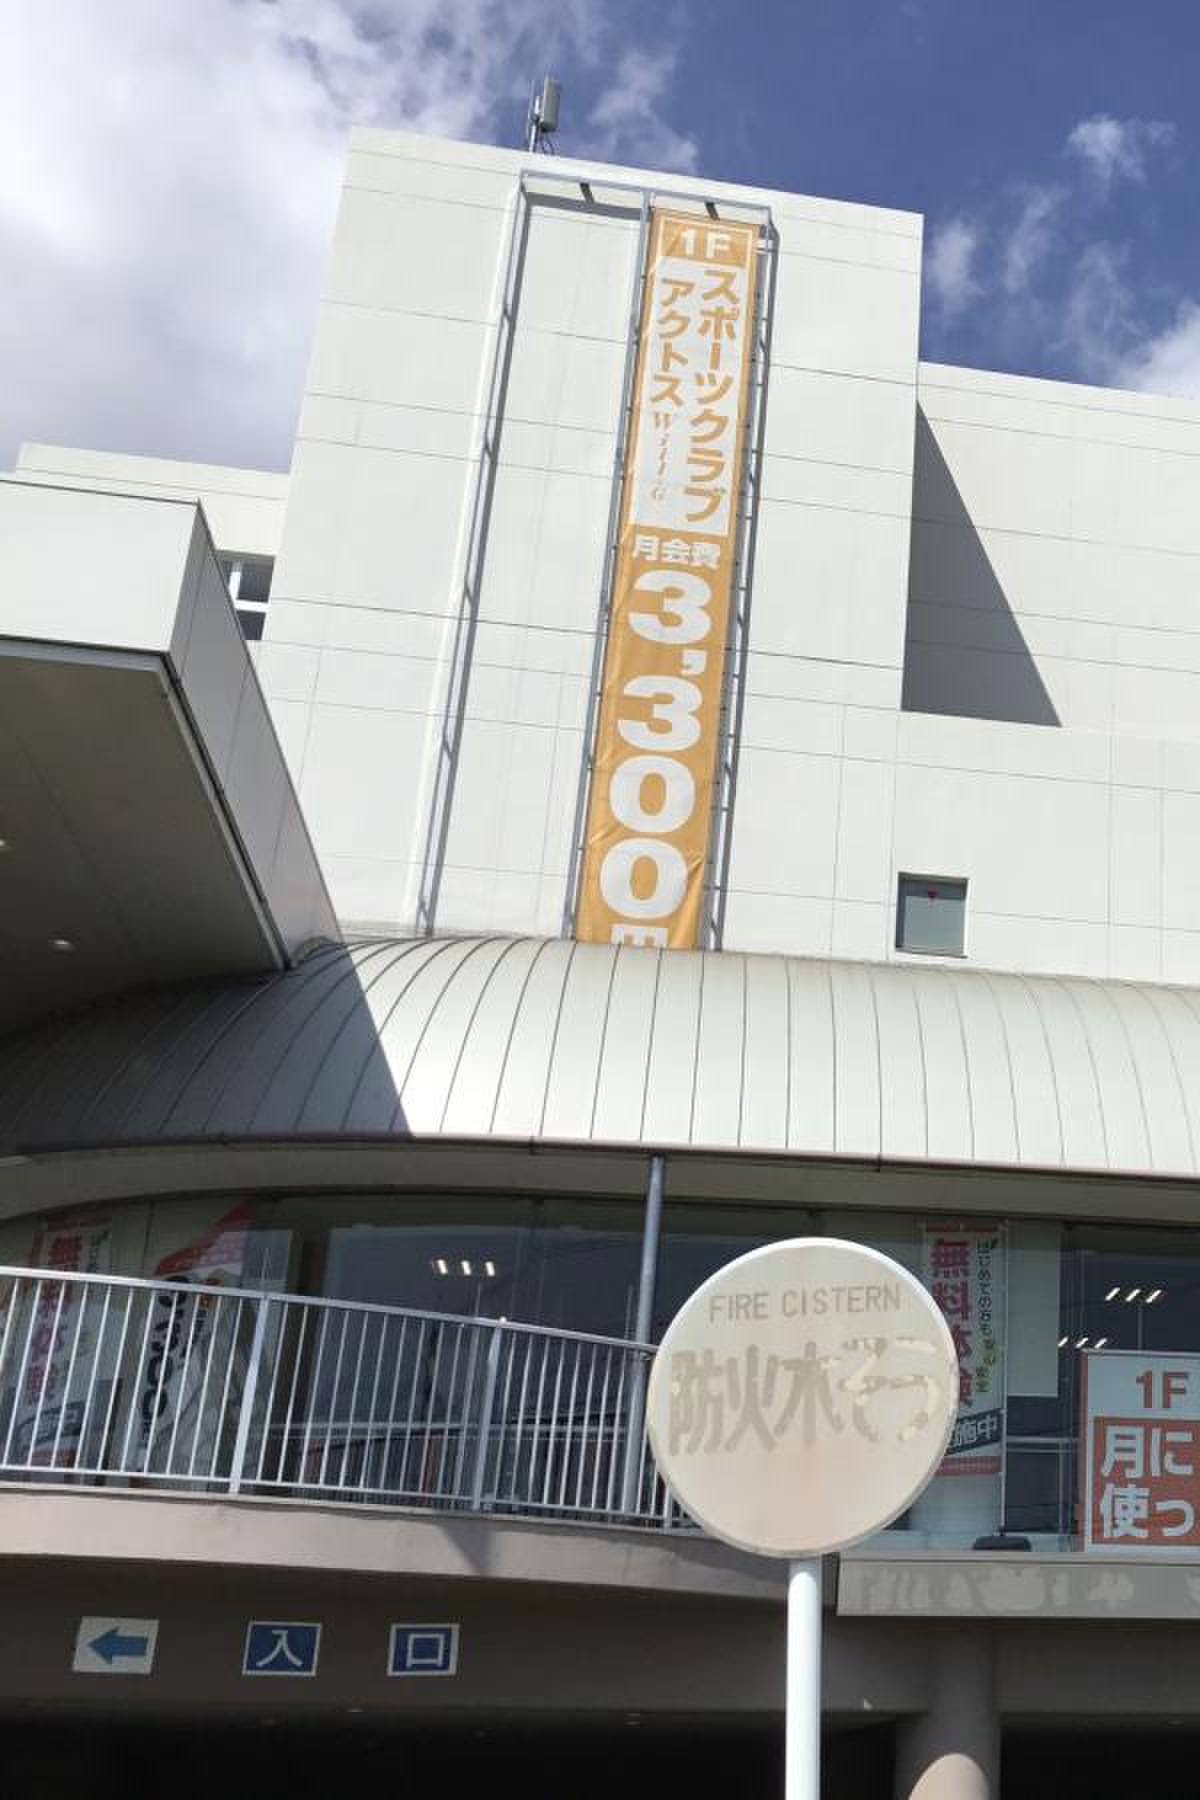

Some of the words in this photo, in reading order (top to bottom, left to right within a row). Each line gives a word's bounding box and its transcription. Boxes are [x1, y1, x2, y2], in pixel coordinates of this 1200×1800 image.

[679, 229, 732, 260] 1F
[650, 277, 696, 407] アクトス
[684, 269, 741, 523] スポーツクラブ
[632, 537, 721, 570] 月会費
[708, 1293, 770, 1324] FIRE
[780, 1283, 901, 1318] CISTERN
[1135, 1369, 1191, 1410] 1F
